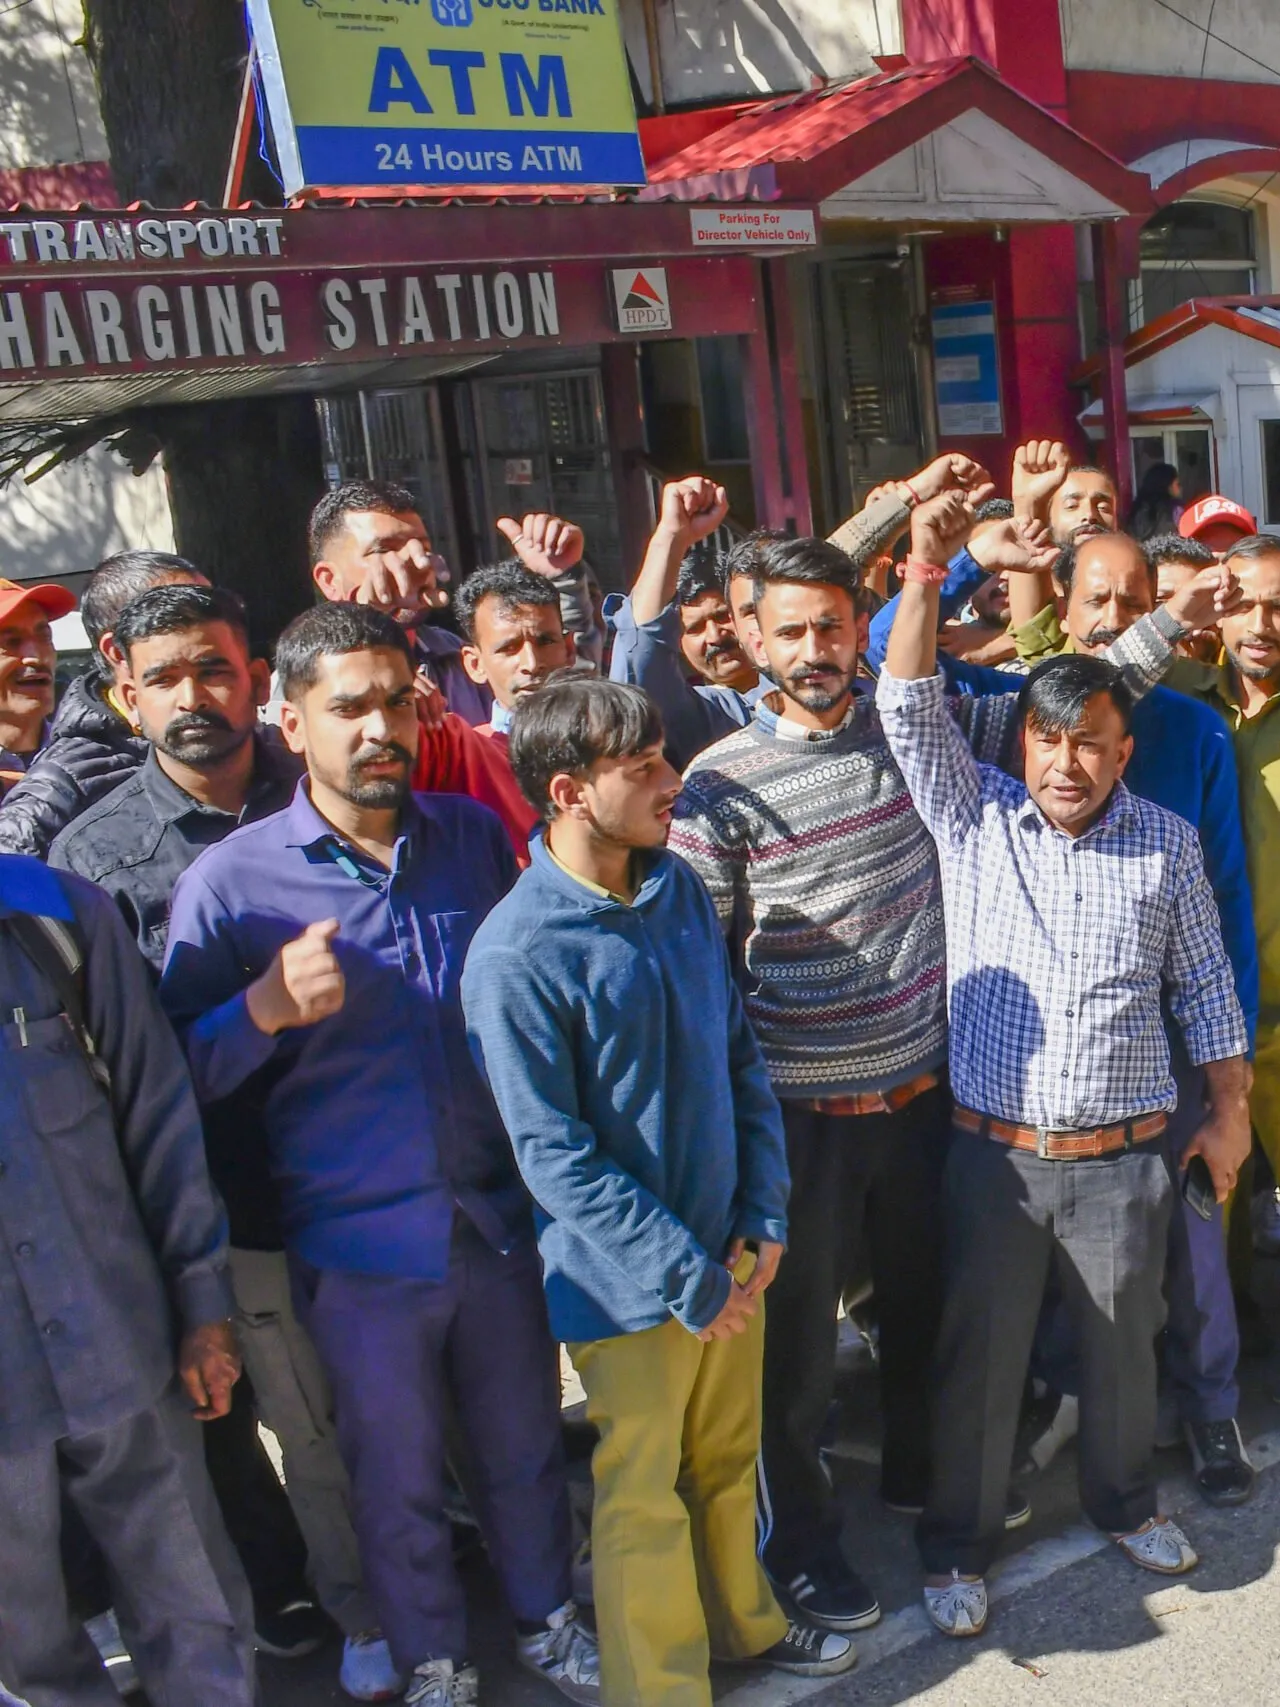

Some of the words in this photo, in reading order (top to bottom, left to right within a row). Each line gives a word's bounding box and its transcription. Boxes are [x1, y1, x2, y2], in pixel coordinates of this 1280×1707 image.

[539, 0, 605, 15] BANK
[368, 46, 573, 118] ATM
[375, 143, 412, 170] 24
[420, 144, 513, 171] Hours
[521, 145, 582, 171] ATM
[719, 213, 760, 226] Parking
[763, 213, 780, 224] For
[0, 217, 283, 262] TRANSPORT
[697, 229, 742, 240] Director
[744, 229, 784, 240] Vehicle
[787, 230, 810, 242] Only
[324, 271, 560, 350] STATION
